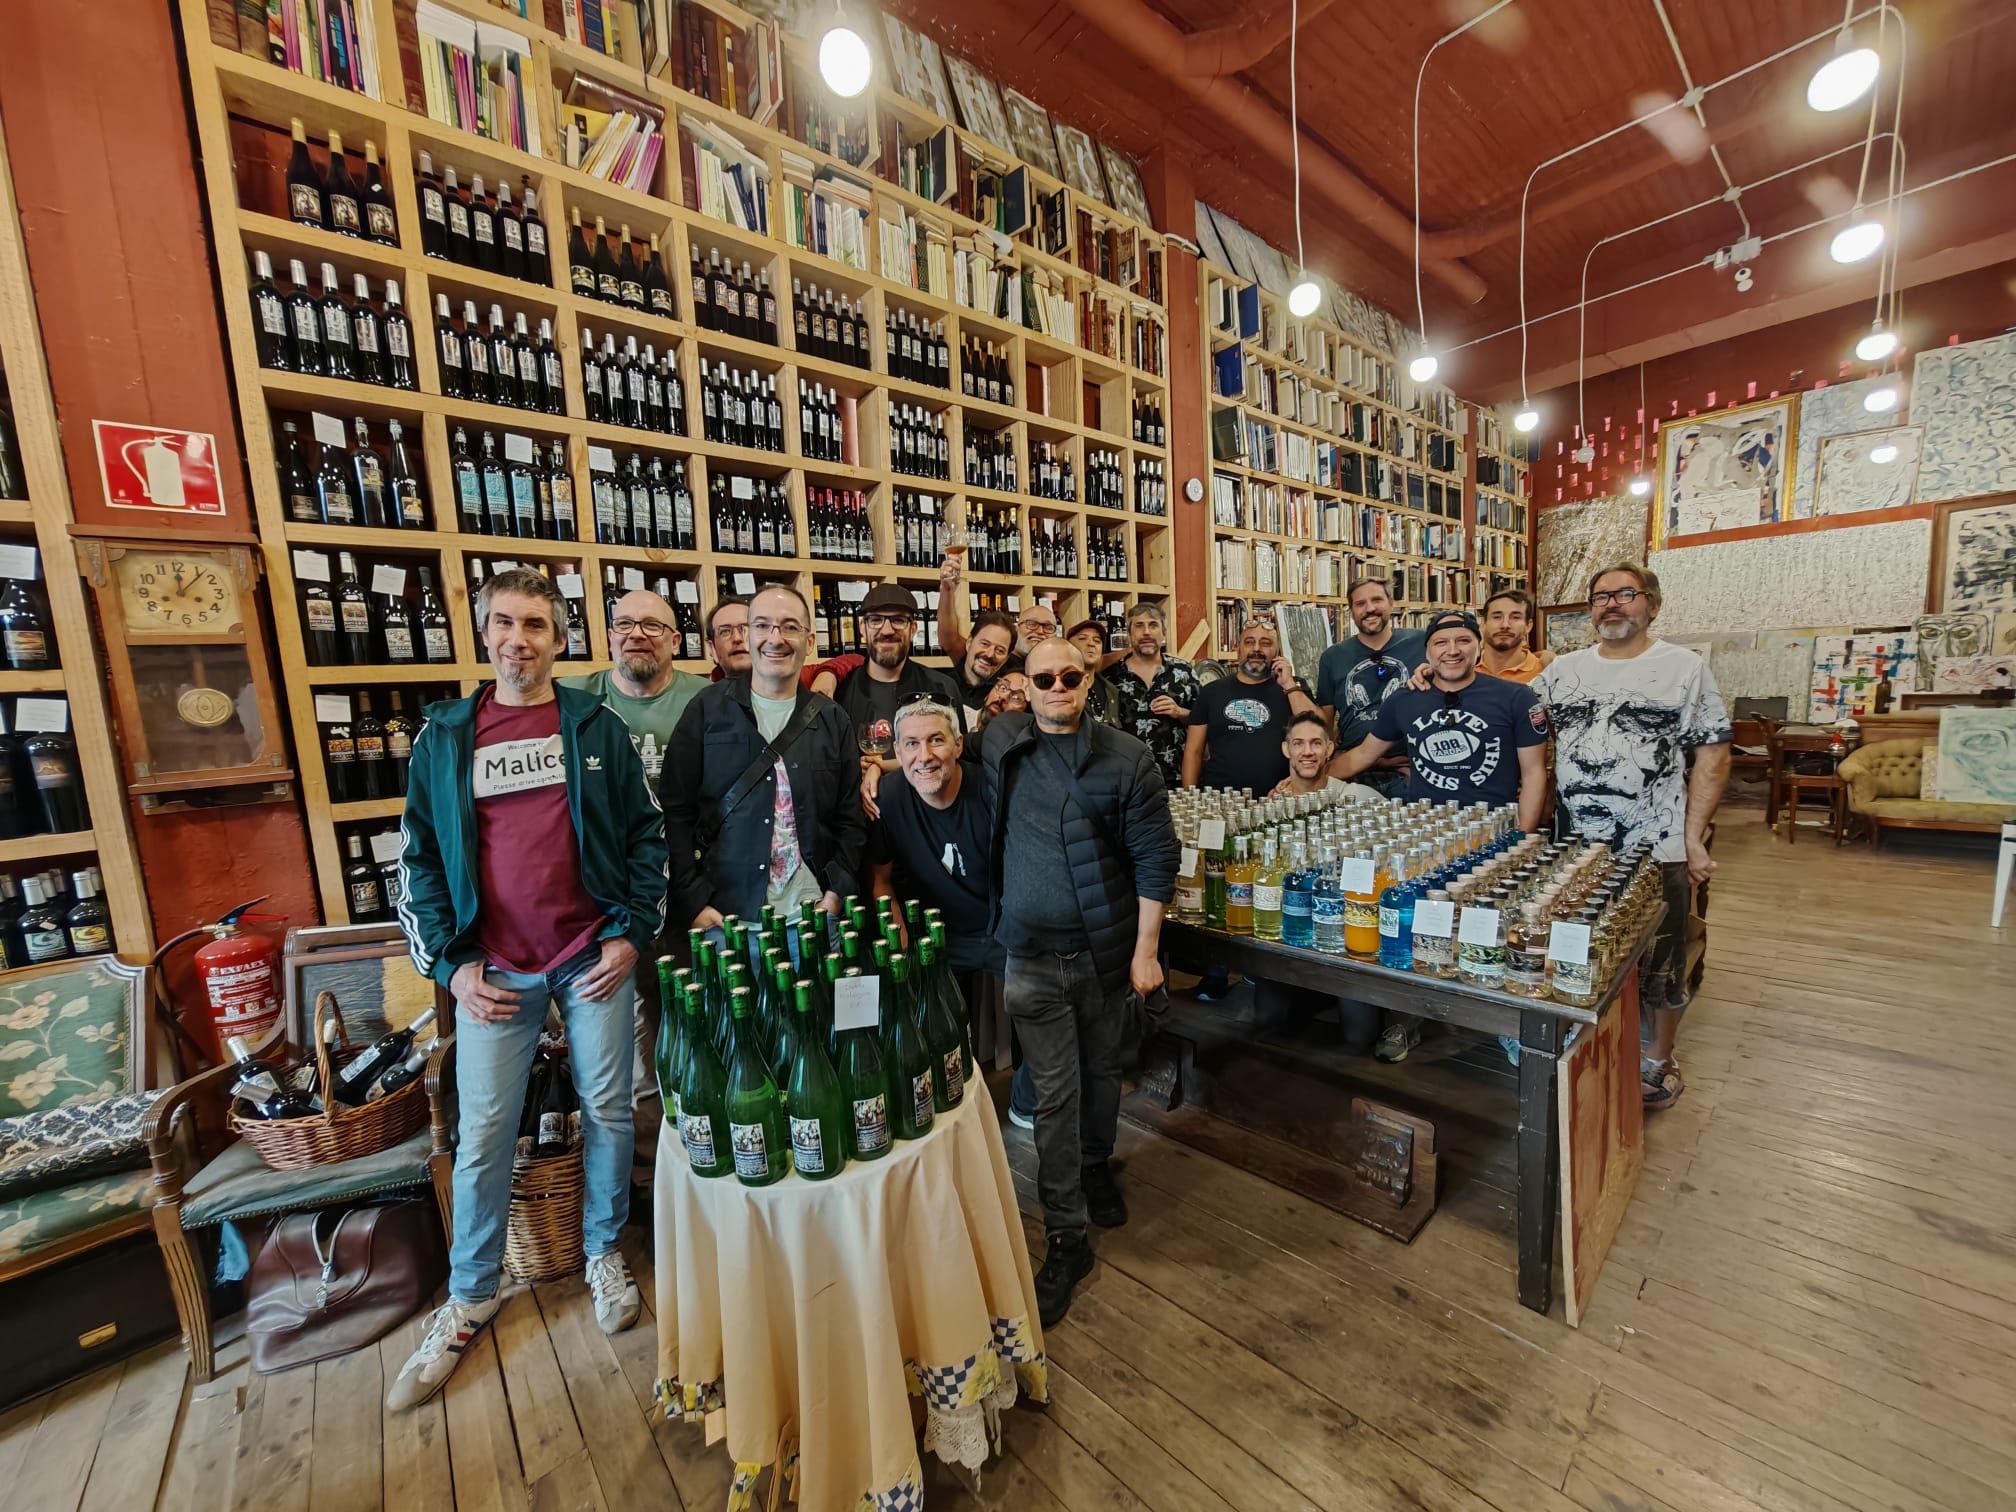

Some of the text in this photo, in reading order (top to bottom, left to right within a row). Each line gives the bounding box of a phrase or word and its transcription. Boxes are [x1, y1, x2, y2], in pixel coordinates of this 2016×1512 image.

[155, 564, 167, 575] 11
[172, 562, 185, 573] 12
[194, 566, 201, 576] 1
[140, 573, 156, 585] 10
[206, 574, 217, 585] 2
[138, 587, 149, 598] 9
[213, 588, 224, 600] 3
[147, 601, 158, 612] 8
[209, 602, 222, 613] 4
[163, 610, 173, 620] 7
[182, 614, 192, 625] 6
[198, 611, 208, 622] 5
[1407, 733, 1417, 746] I
[1433, 738, 1460, 751] 100
[508, 743, 537, 751] Welcome
[1469, 737, 1501, 786] THIS
[1412, 757, 1460, 791] SHIT
[493, 782, 516, 791] Please
